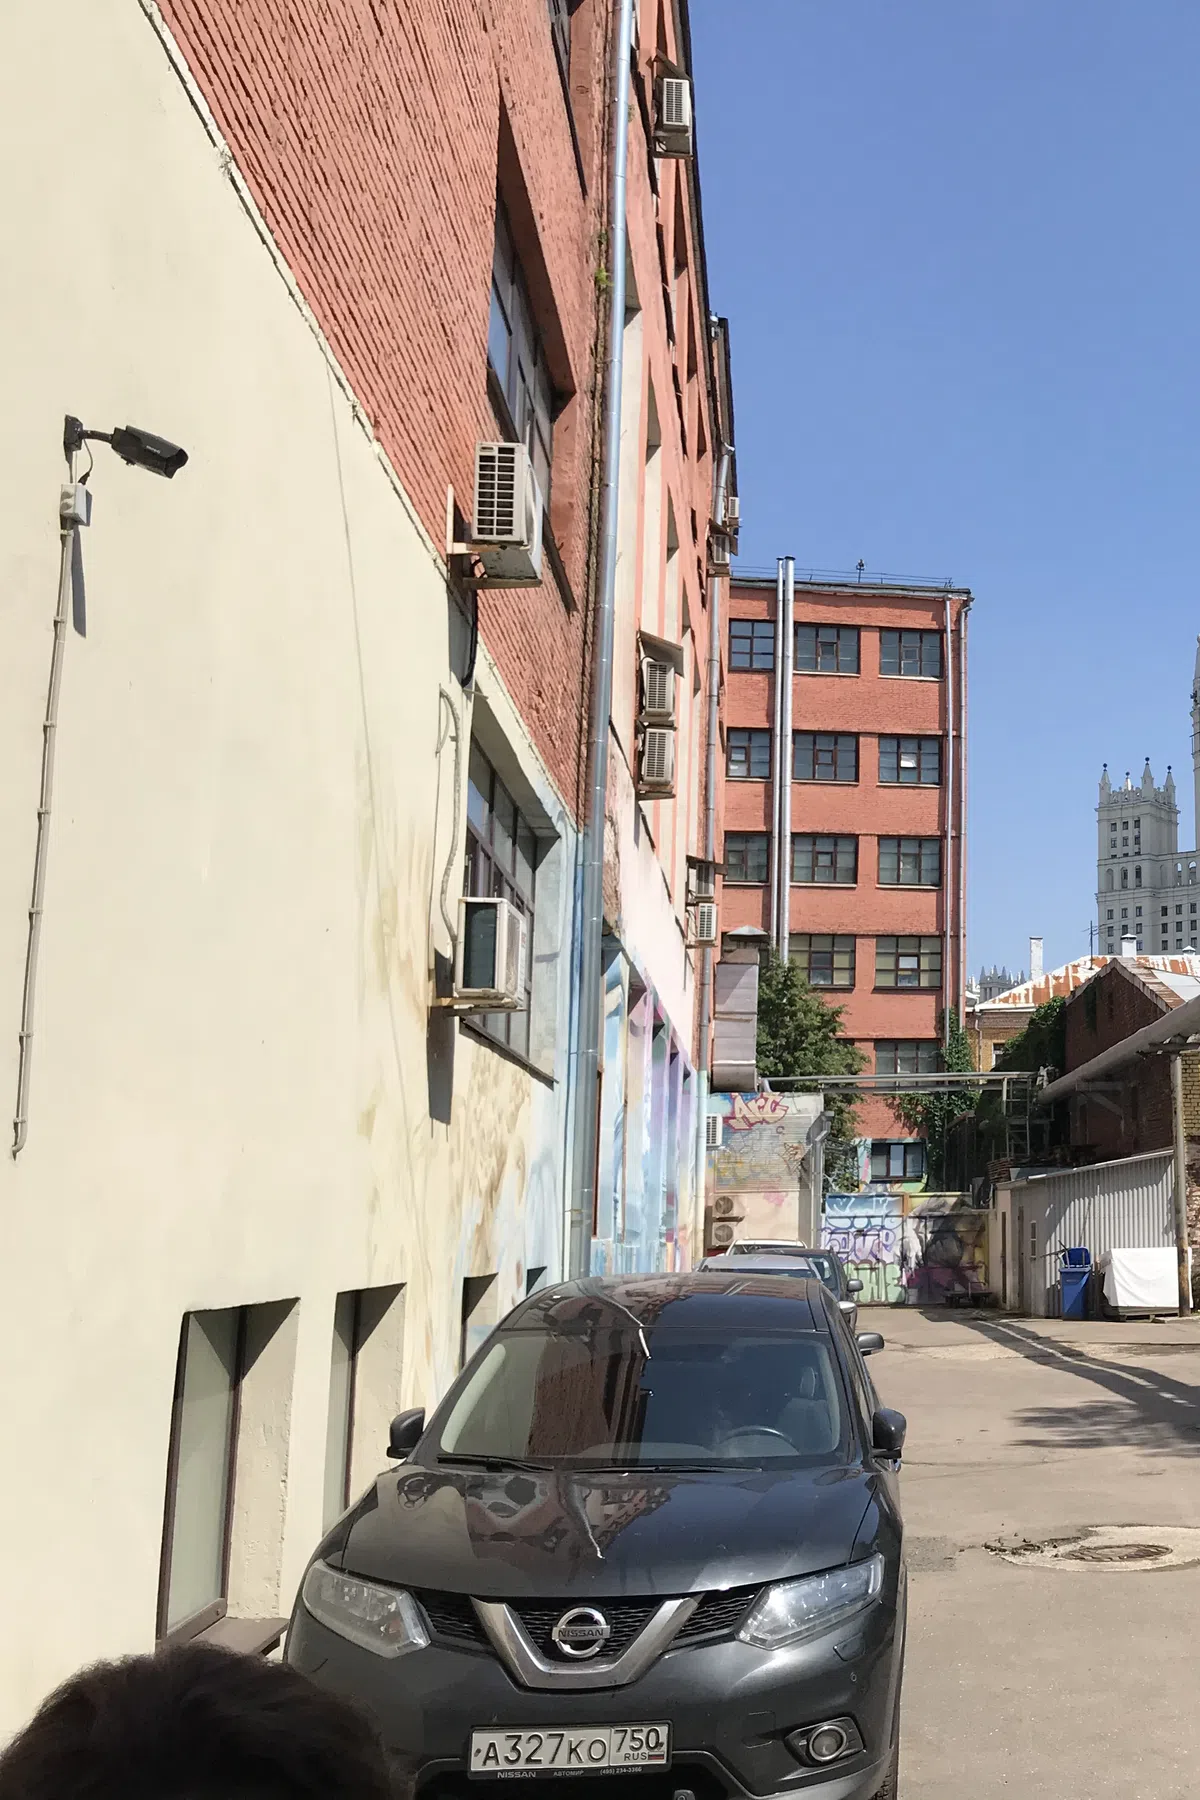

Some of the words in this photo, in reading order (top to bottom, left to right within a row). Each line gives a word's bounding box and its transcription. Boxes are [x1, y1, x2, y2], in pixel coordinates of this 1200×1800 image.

[557, 1628, 604, 1637] NISSAN
[613, 1727, 660, 1752] 750
[623, 1752, 648, 1761] RUS
[497, 1770, 536, 1779] NISSAN
